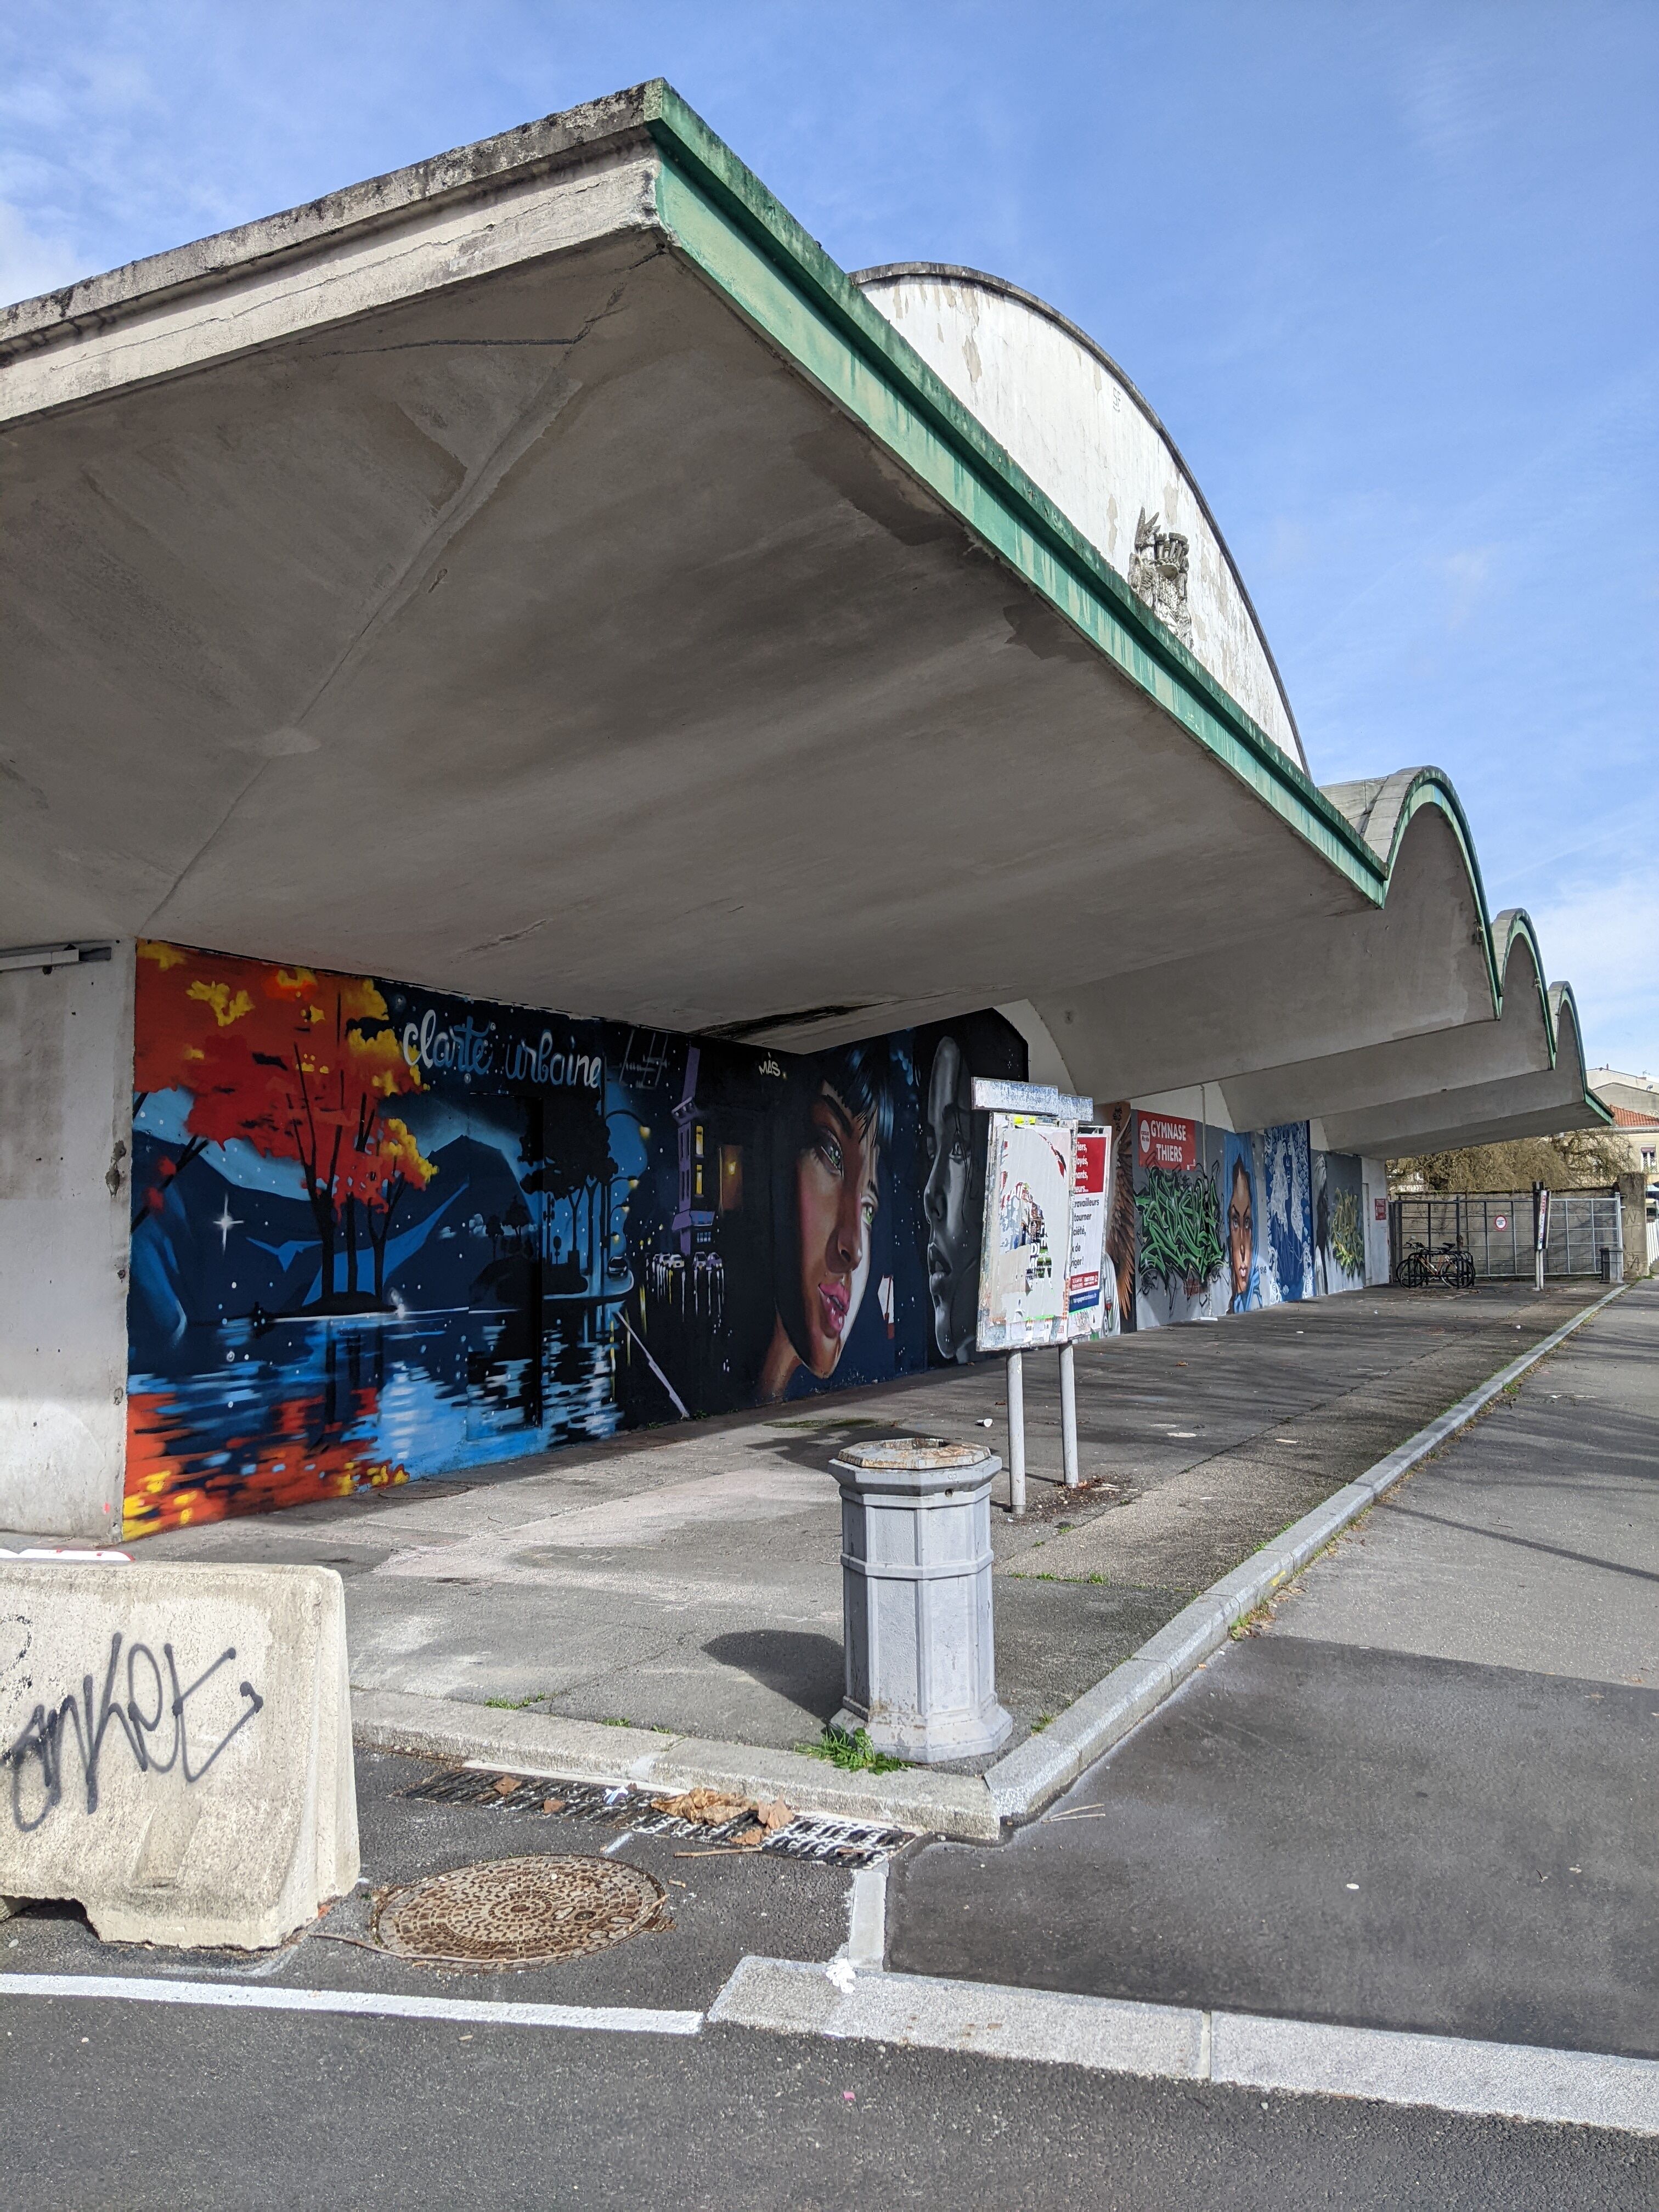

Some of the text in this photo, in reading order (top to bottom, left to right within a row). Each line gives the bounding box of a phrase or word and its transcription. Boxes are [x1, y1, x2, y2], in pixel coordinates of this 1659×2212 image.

[505, 1029, 602, 1089] urbaine
[1150, 1120, 1186, 1141] GYMNASE
[1156, 1143, 1182, 1163] THIERS
[1074, 1213, 1092, 1222] tourner
[1075, 1243, 1081, 1252] de
